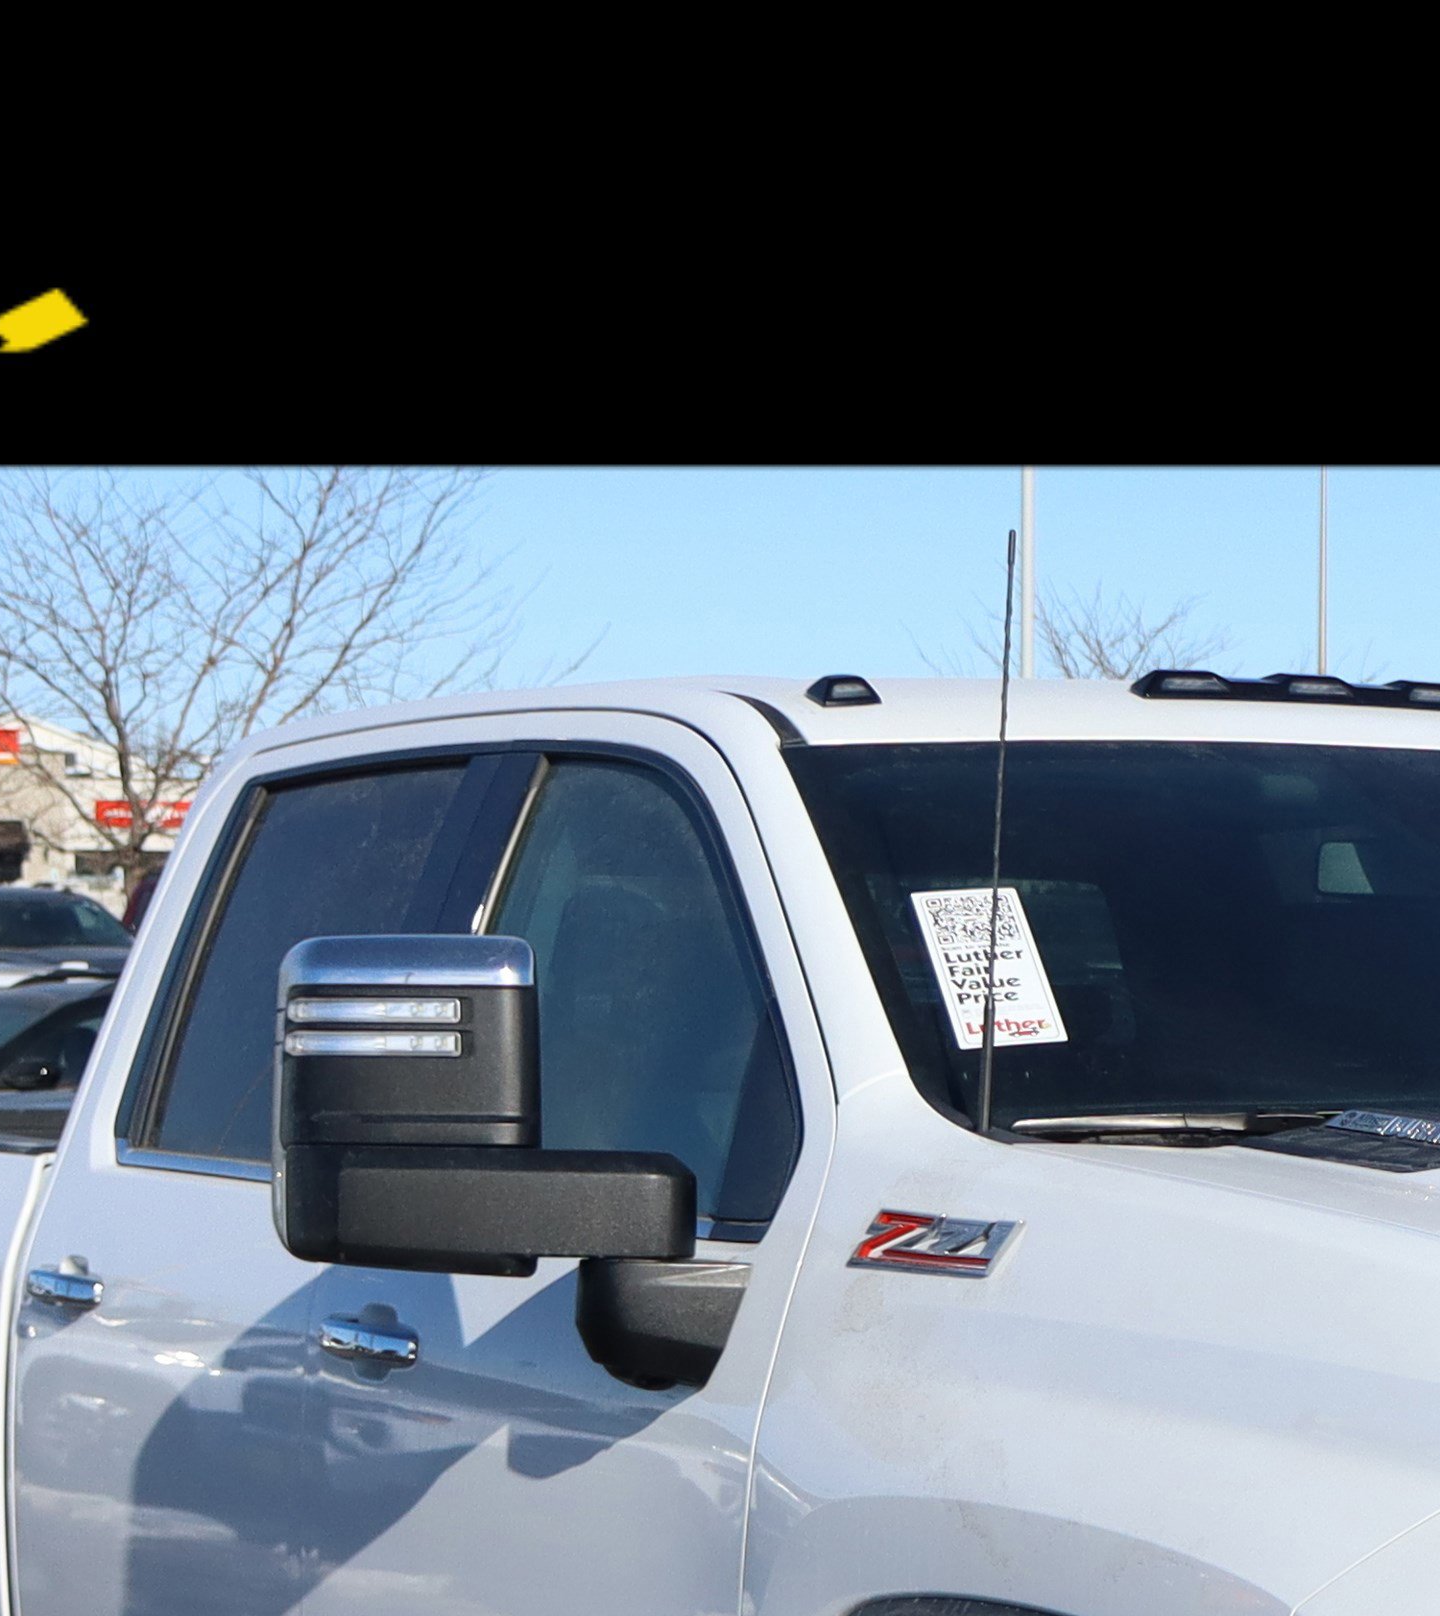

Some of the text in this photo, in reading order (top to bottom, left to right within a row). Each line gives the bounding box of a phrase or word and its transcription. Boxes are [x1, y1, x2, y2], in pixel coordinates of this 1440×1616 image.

[943, 949, 1023, 964] Luther
[951, 977, 1021, 990] Value
[846, 1208, 1022, 1277] Z71
